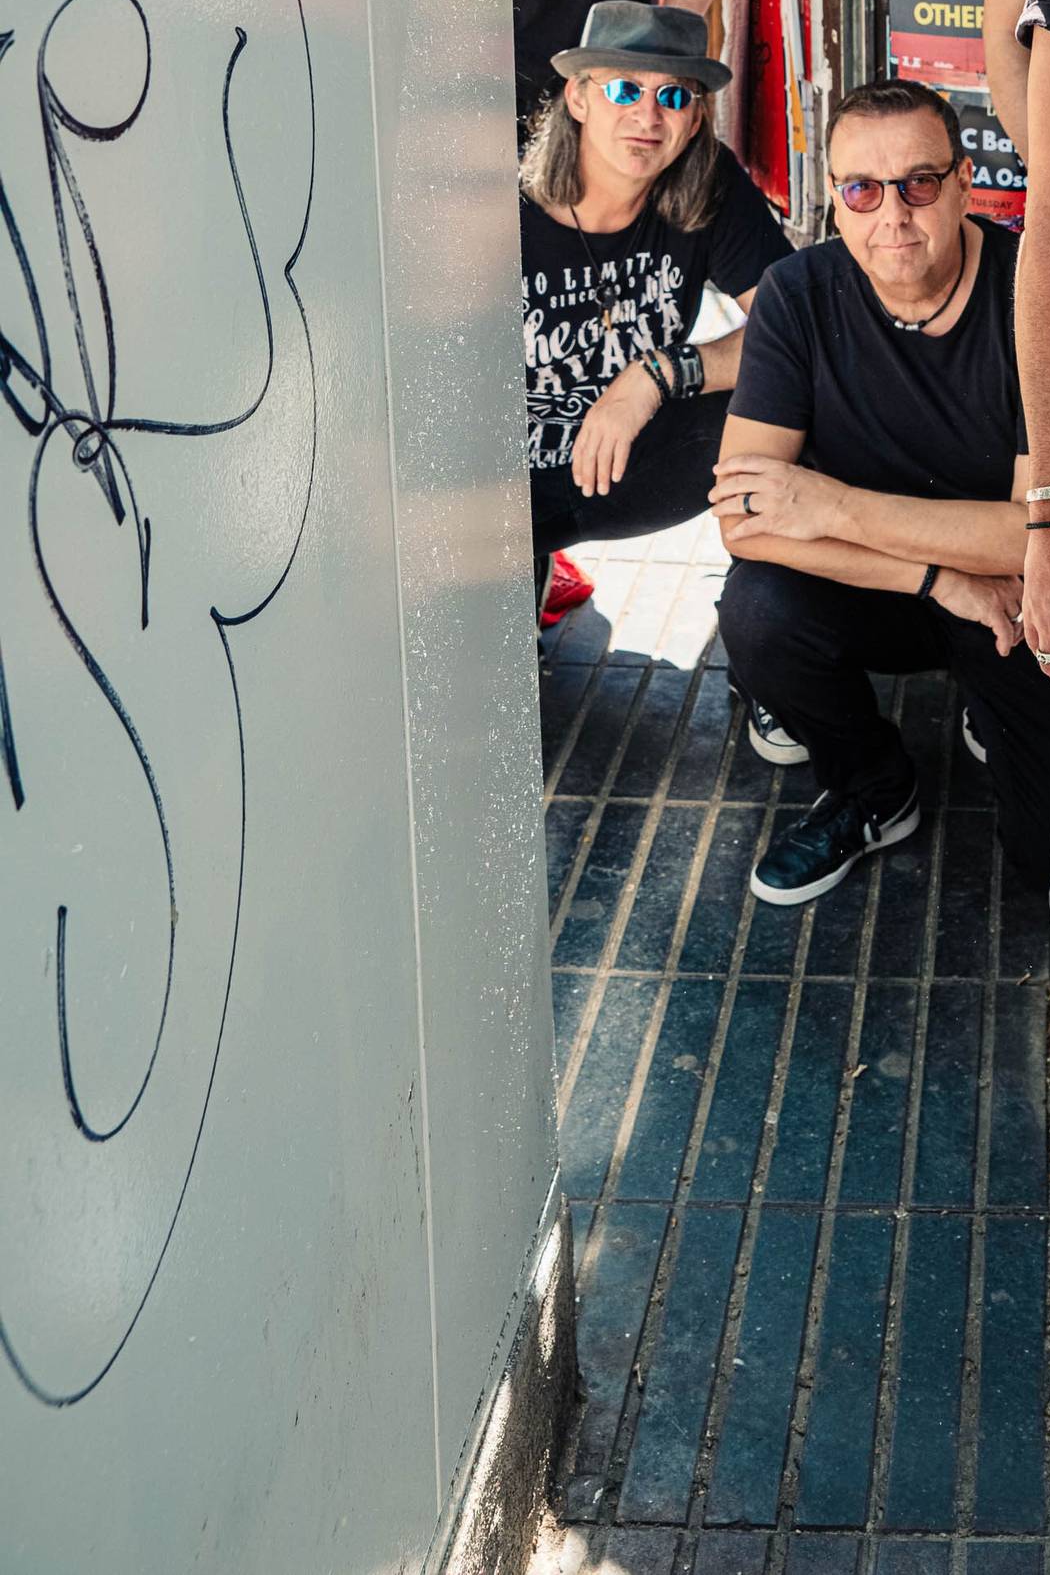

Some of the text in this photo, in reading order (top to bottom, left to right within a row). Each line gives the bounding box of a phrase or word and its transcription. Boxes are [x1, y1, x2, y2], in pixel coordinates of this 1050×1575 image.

[983, 130, 1017, 153] Ba
[996, 168, 1027, 187] Os
[971, 198, 1013, 209] TUESDAY
